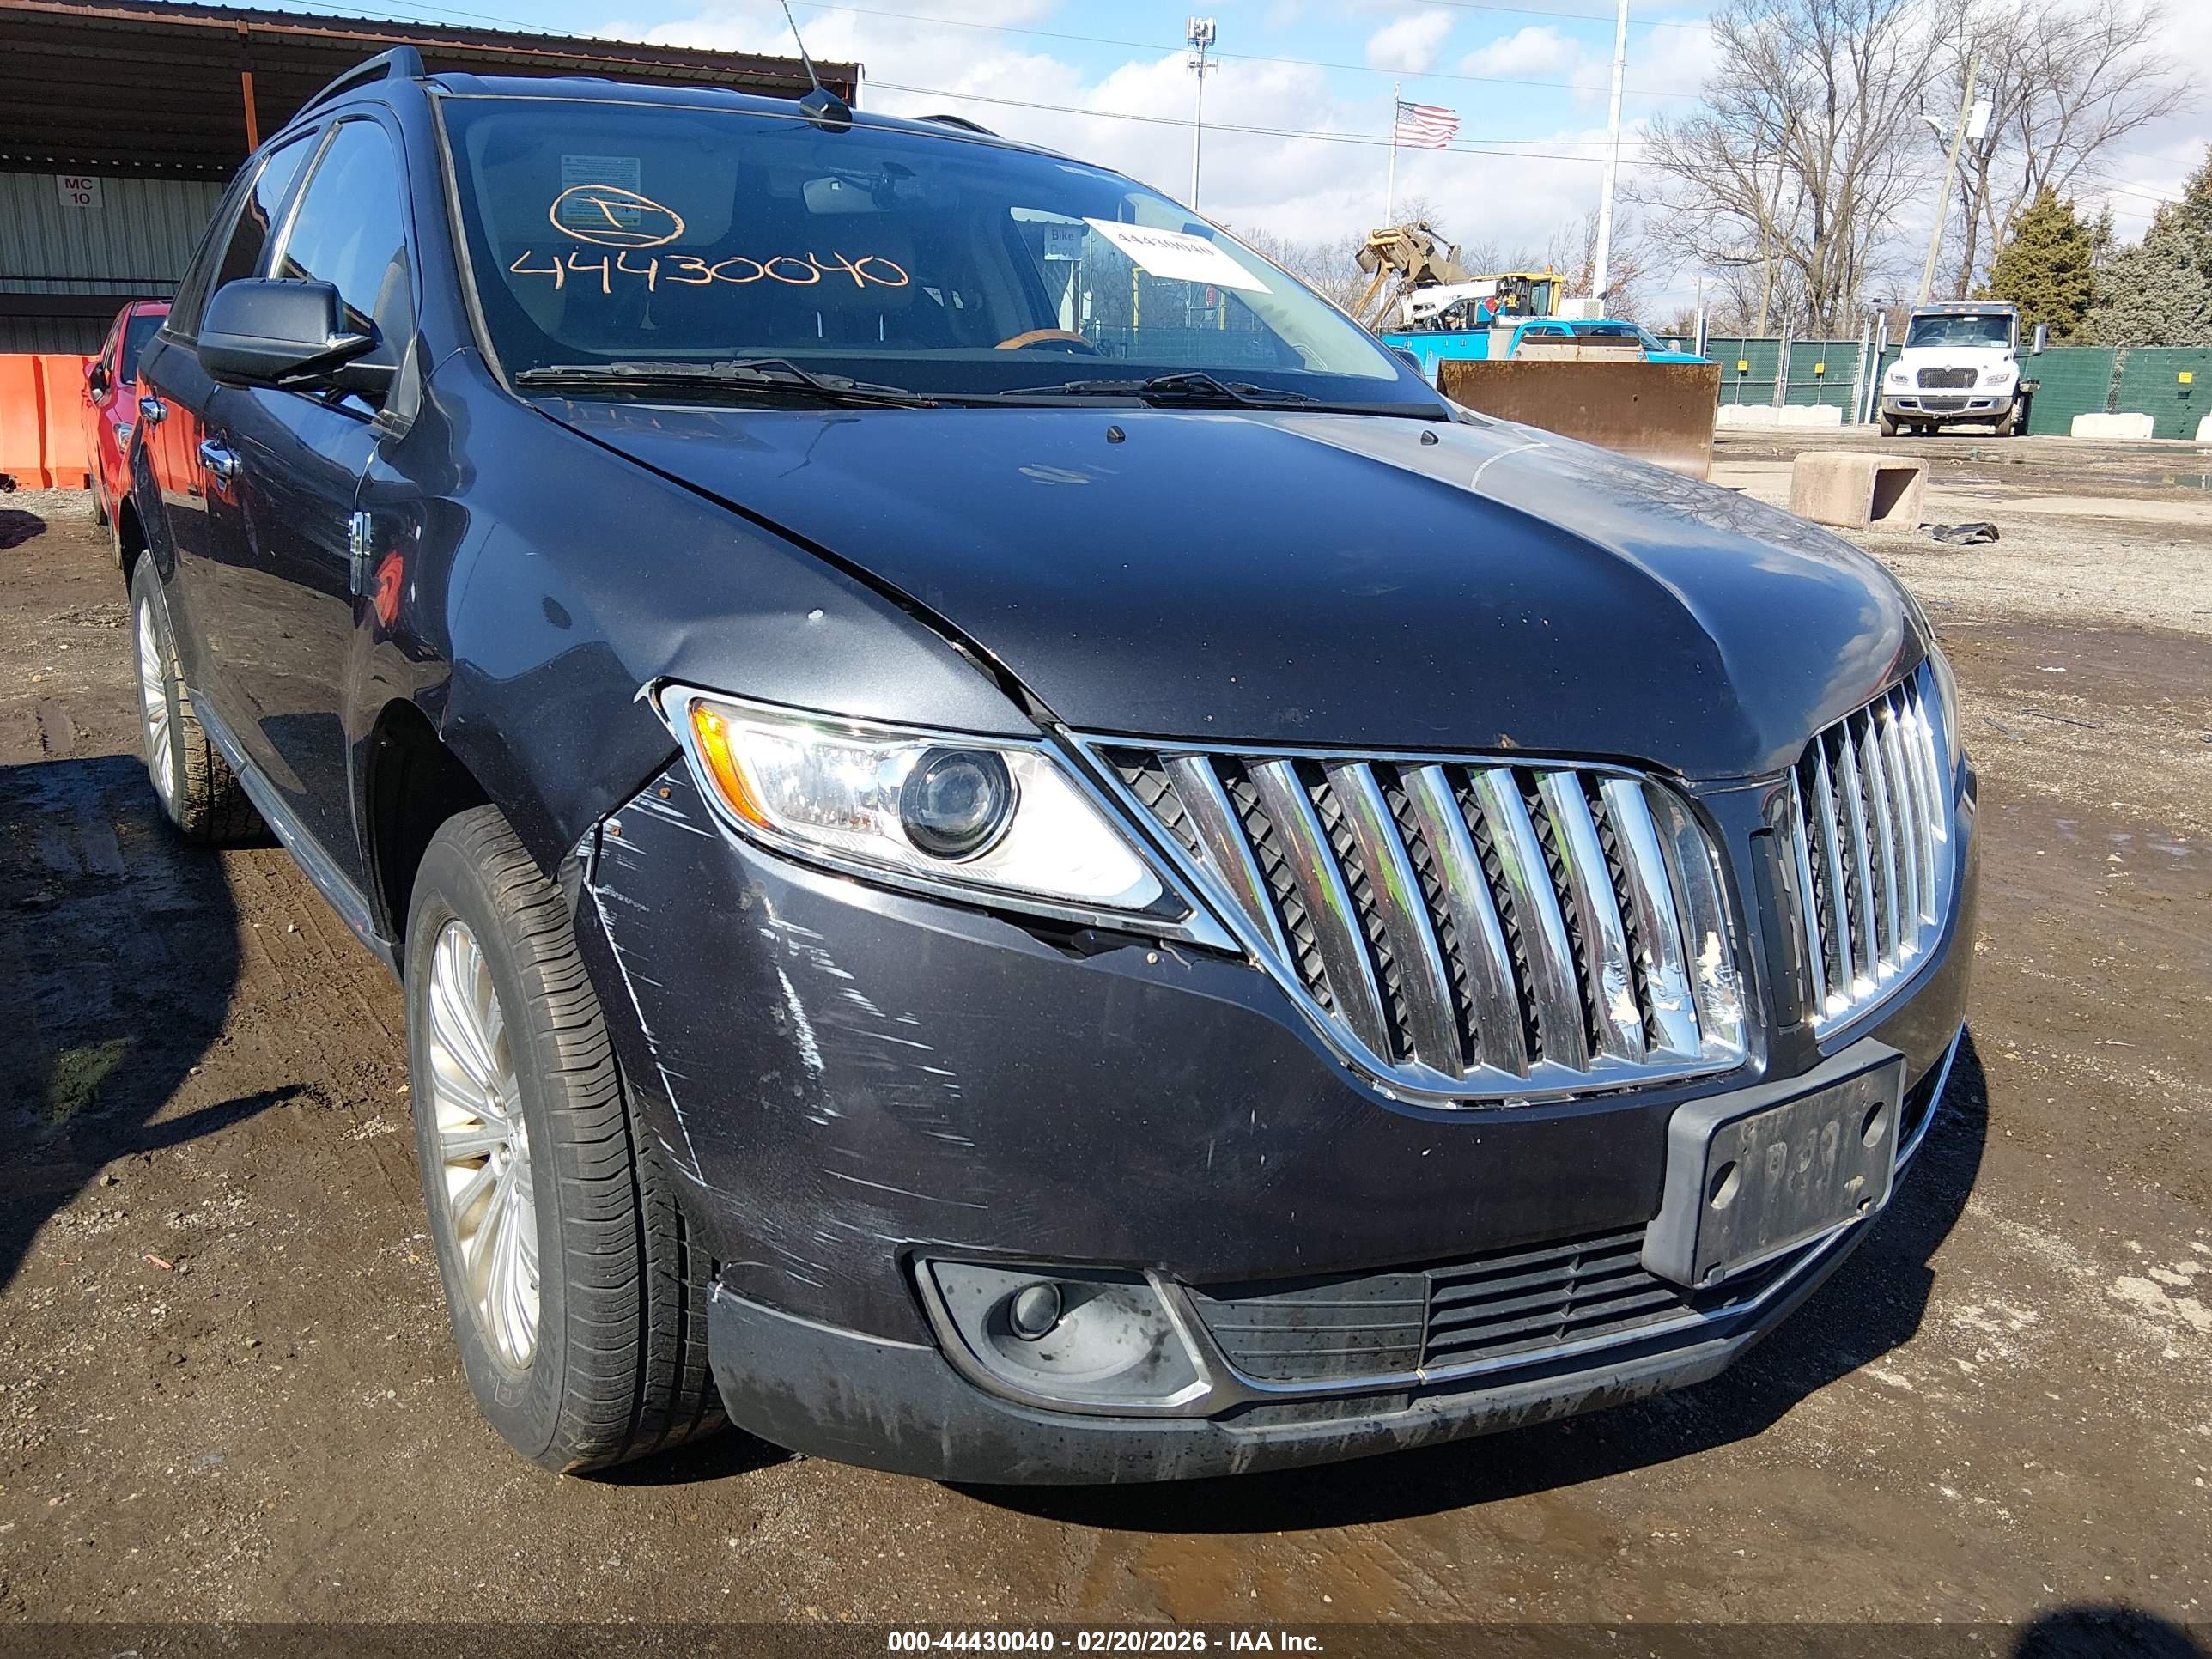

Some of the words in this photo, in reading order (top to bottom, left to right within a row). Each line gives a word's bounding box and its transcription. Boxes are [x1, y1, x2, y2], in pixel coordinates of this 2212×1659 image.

[64, 178, 94, 190] MC
[70, 193, 91, 204] 10
[1051, 228, 1075, 241] Bike
[509, 248, 909, 294] 44430040
